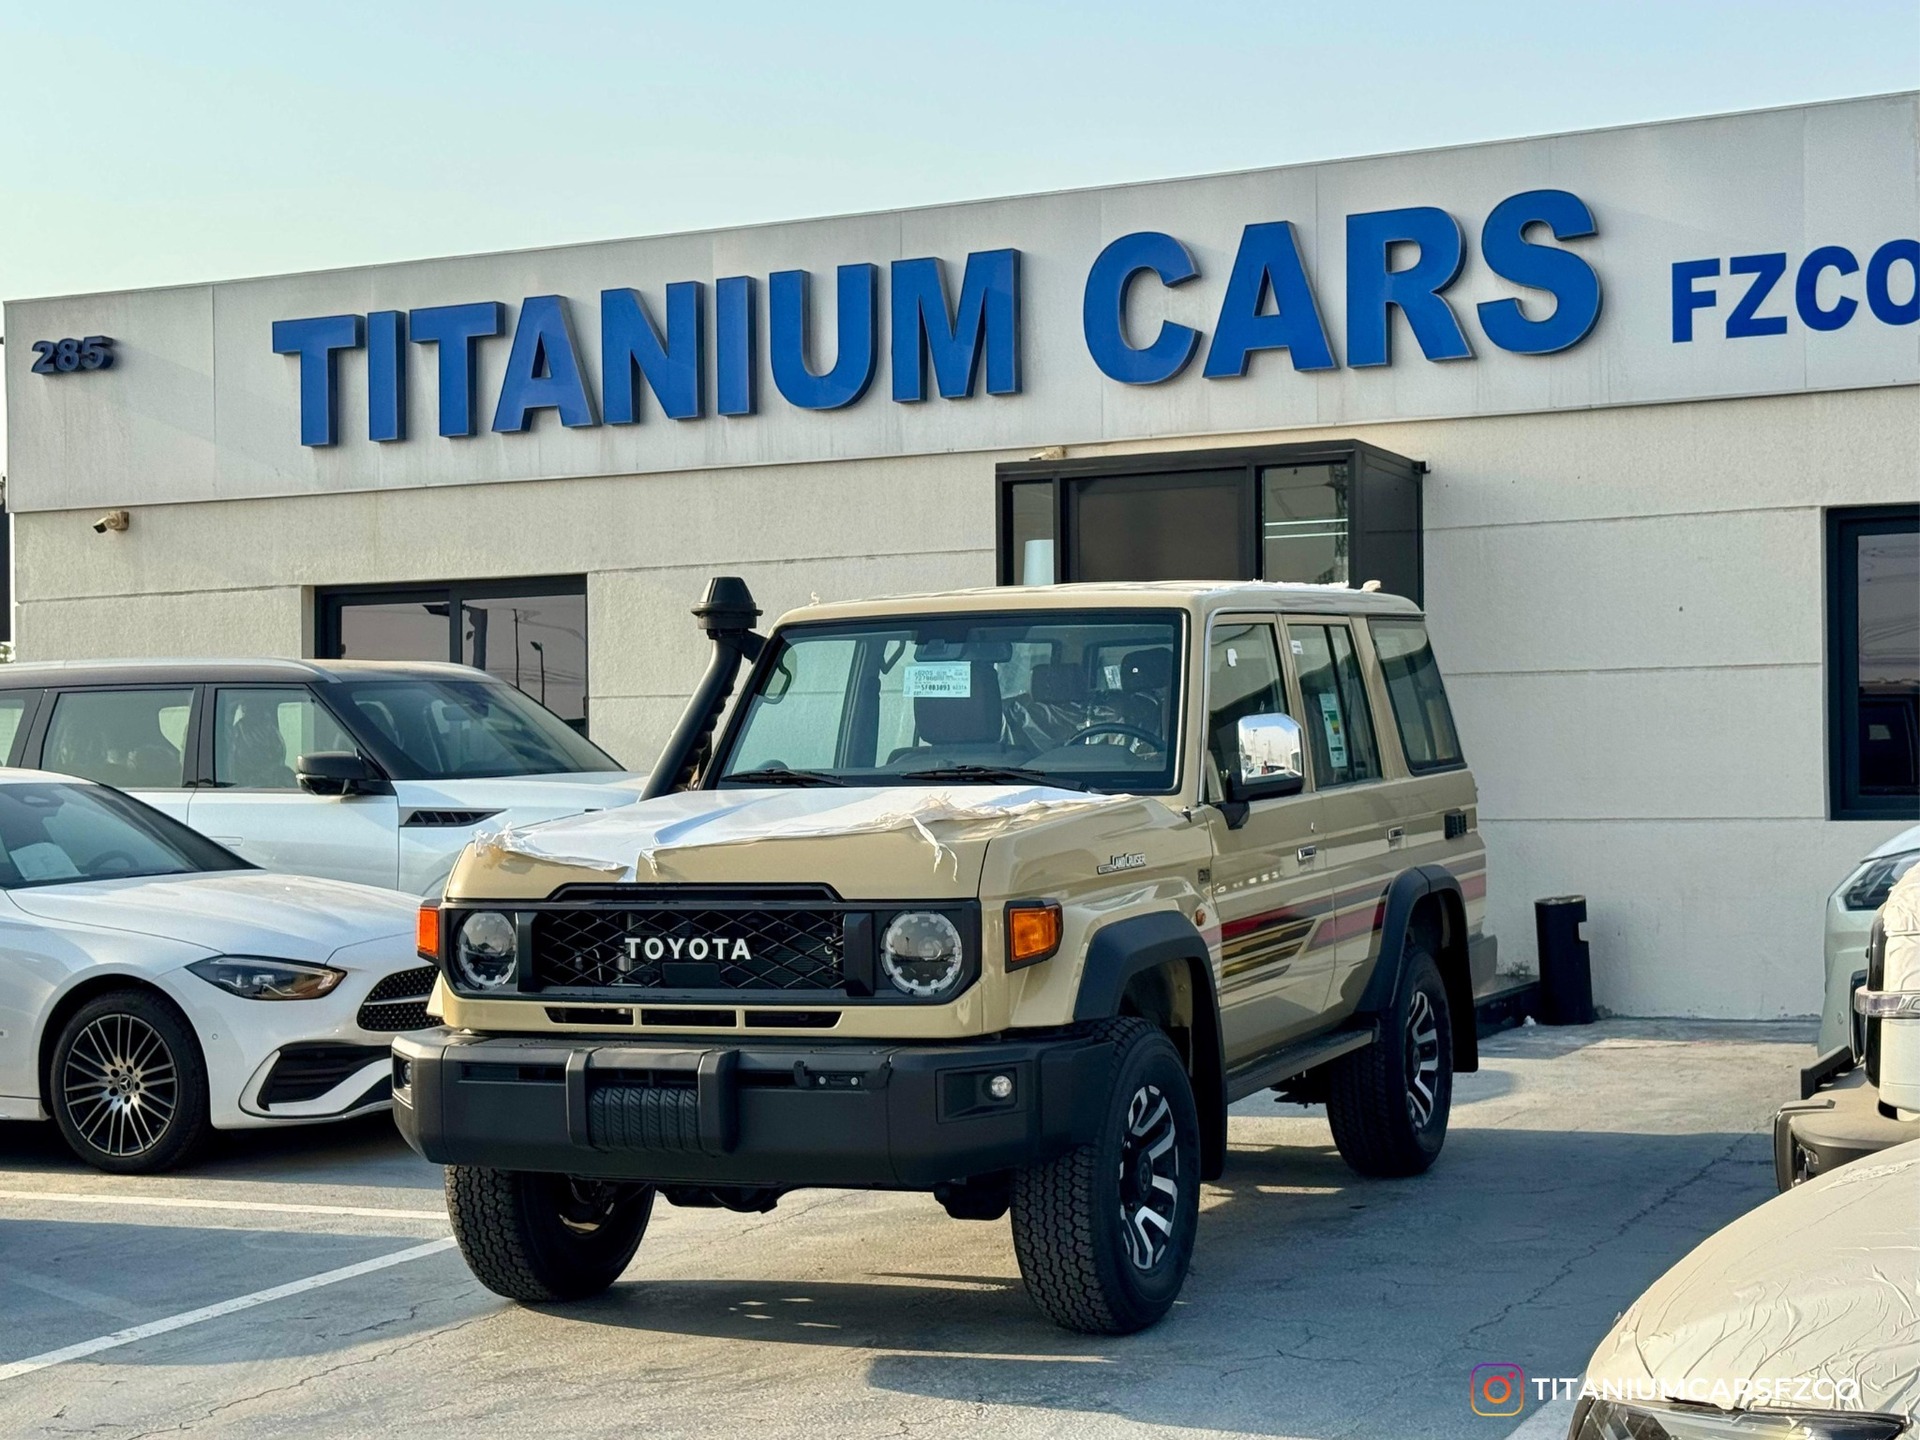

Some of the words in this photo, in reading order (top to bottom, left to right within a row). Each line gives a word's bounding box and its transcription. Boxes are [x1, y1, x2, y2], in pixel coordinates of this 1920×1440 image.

[272, 248, 1022, 448] TITANIUM
[1083, 189, 1602, 385] CARS
[1672, 239, 1920, 344] FZCO
[31, 335, 114, 375] 285
[625, 937, 751, 960] TOYOTA
